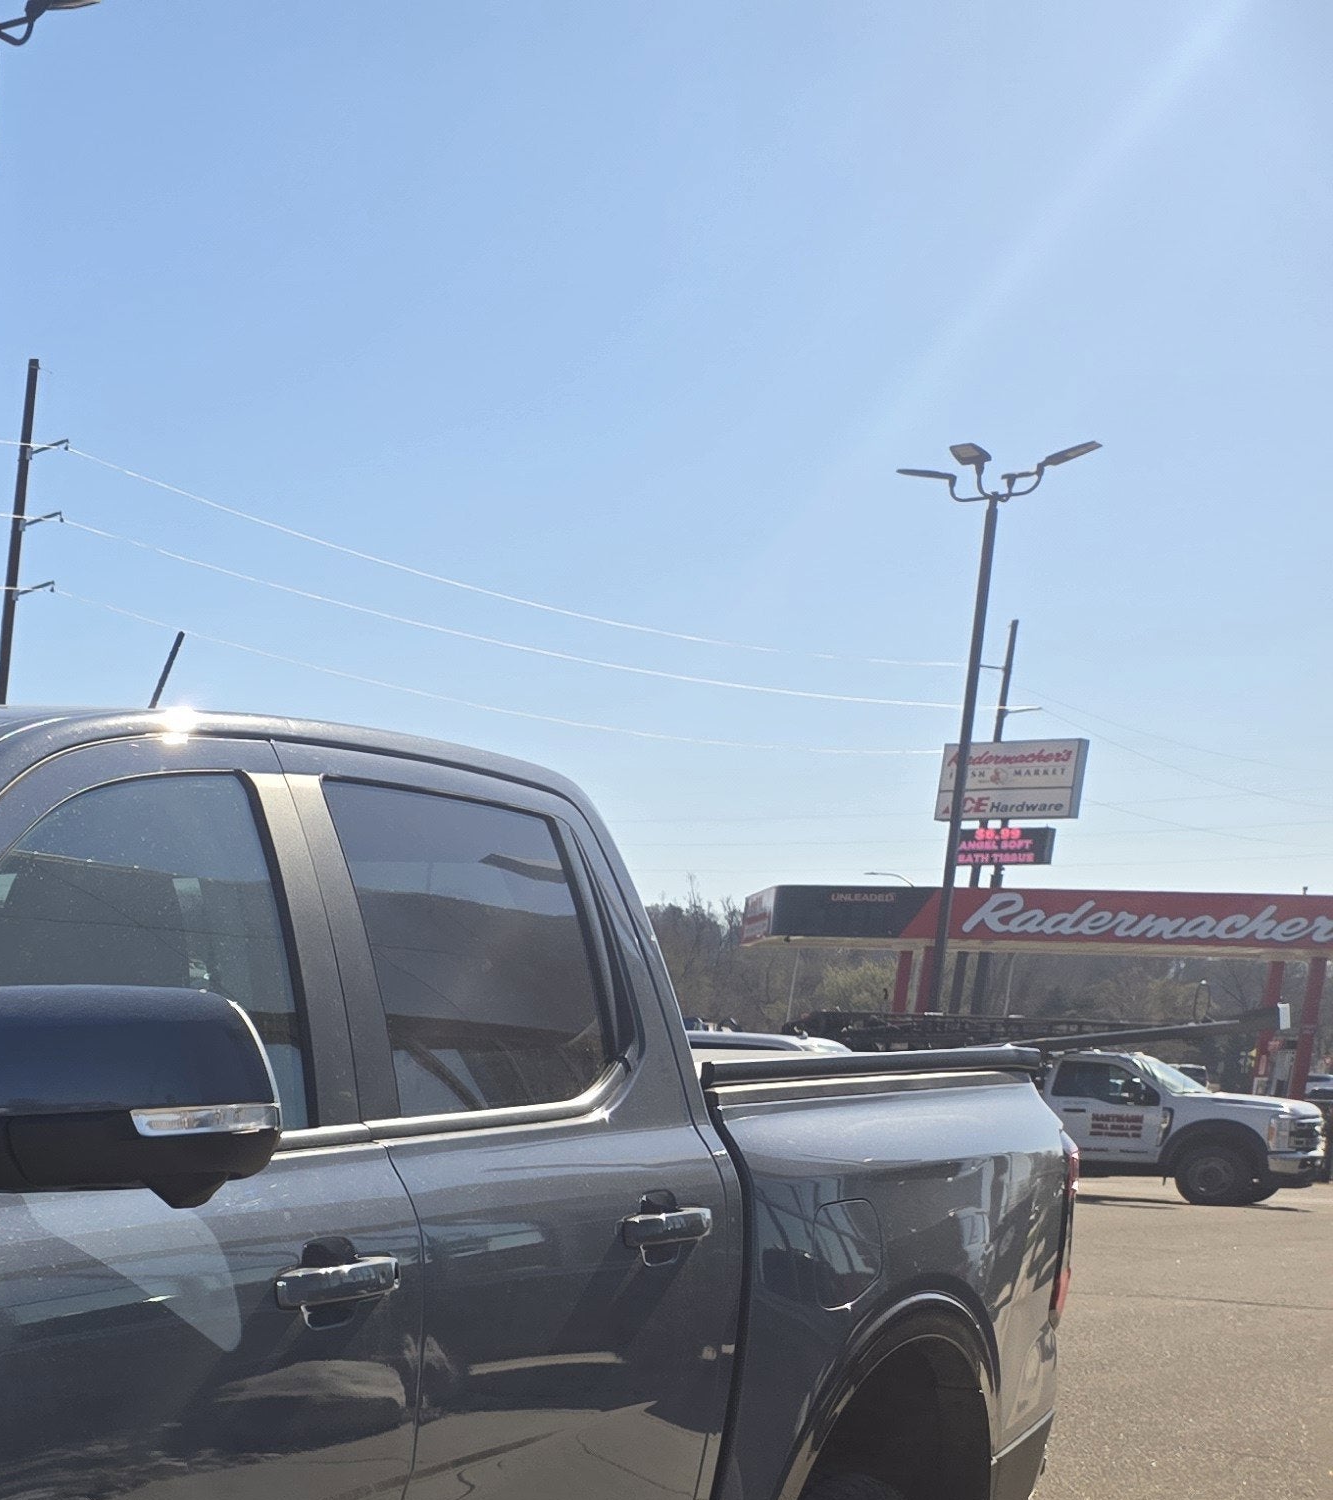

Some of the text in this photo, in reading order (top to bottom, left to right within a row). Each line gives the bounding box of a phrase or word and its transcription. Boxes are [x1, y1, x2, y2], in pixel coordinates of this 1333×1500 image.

[947, 749, 1073, 767] dermacher's
[1012, 768, 1066, 777] MARKET
[989, 802, 1064, 813] Hardware
[1001, 839, 1032, 849] SOFT
[831, 892, 895, 902] UNLEADED
